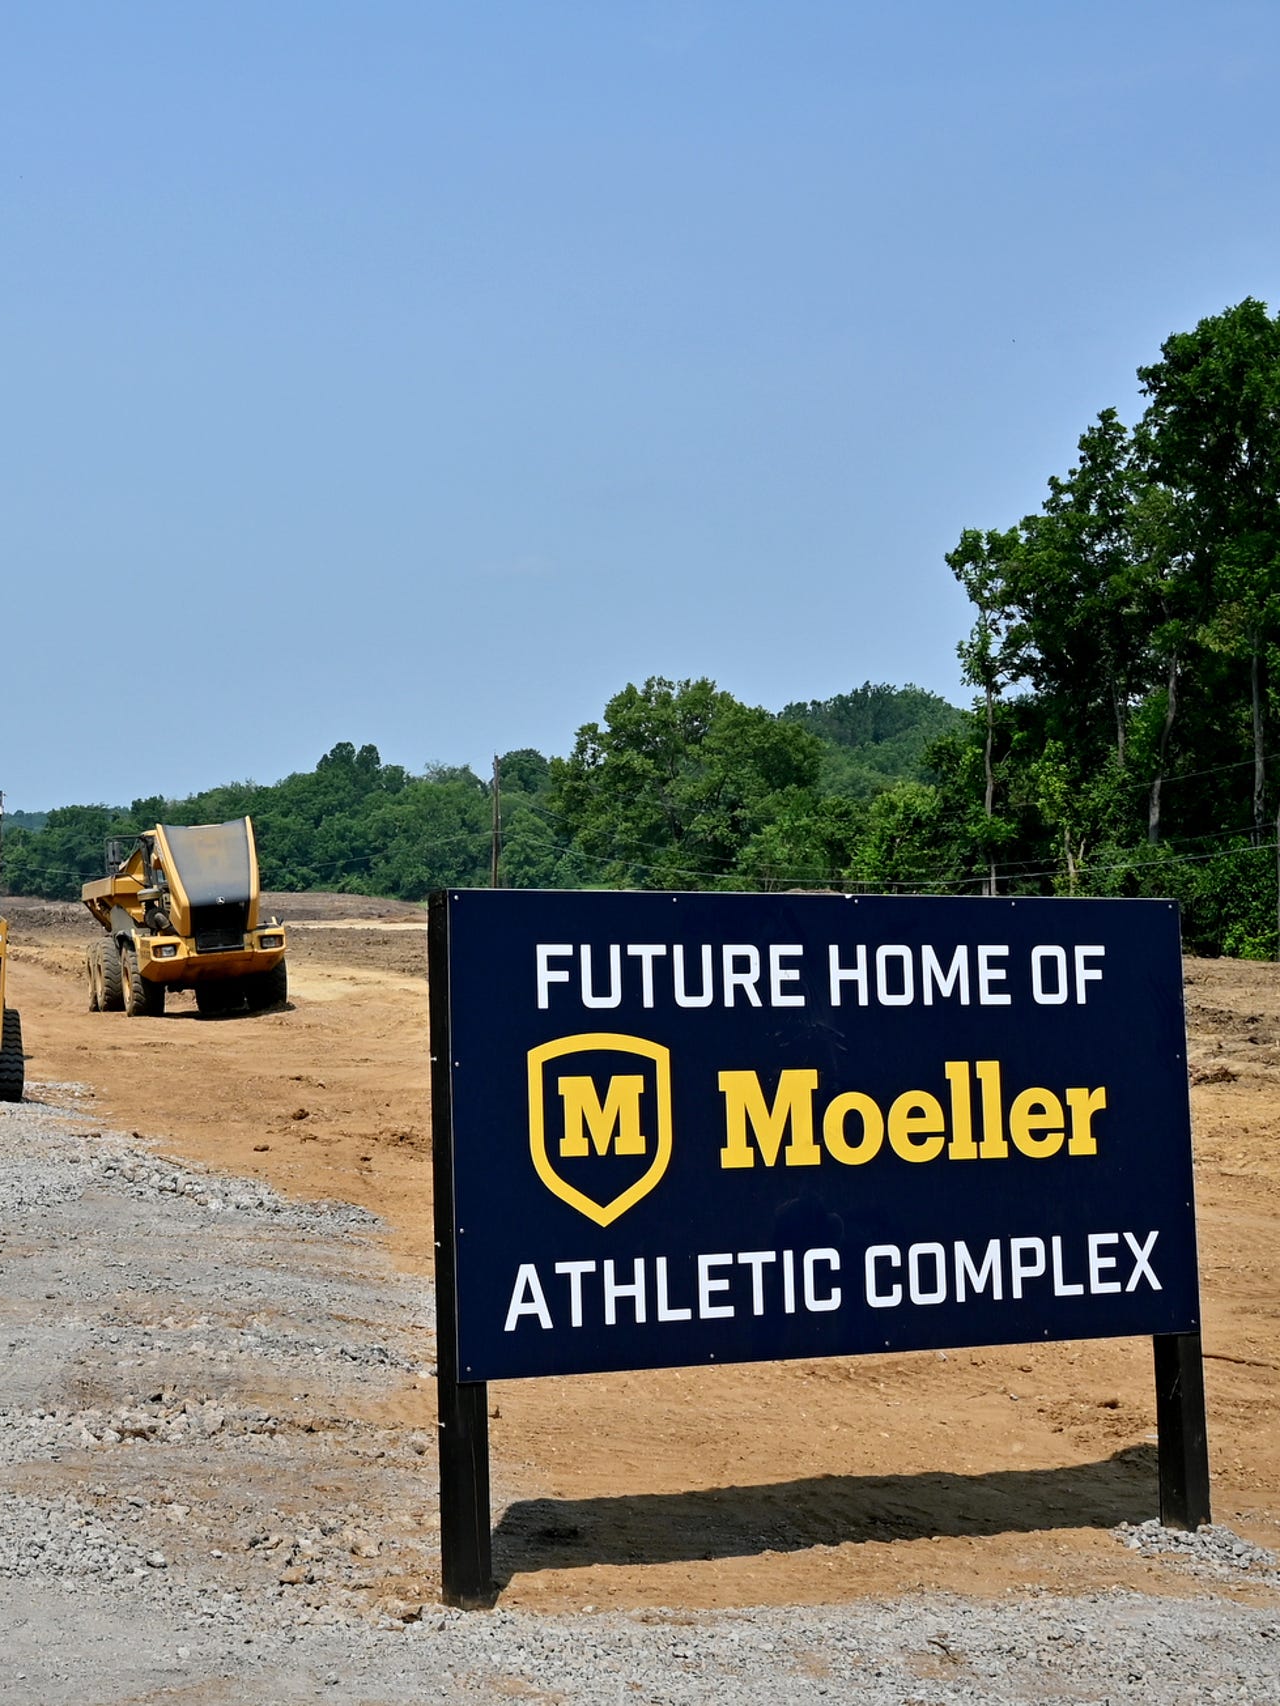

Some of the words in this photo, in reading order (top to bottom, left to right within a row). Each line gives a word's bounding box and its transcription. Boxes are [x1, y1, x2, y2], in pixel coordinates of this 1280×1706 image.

[536, 943, 806, 1010] FUTURE
[828, 944, 1012, 1007] HOME
[1031, 944, 1106, 1005] OF
[557, 1074, 646, 1157] M
[717, 1060, 1107, 1169] Moeller
[503, 1247, 842, 1332] ATHLETIC
[864, 1230, 1163, 1308] COMPLEX
